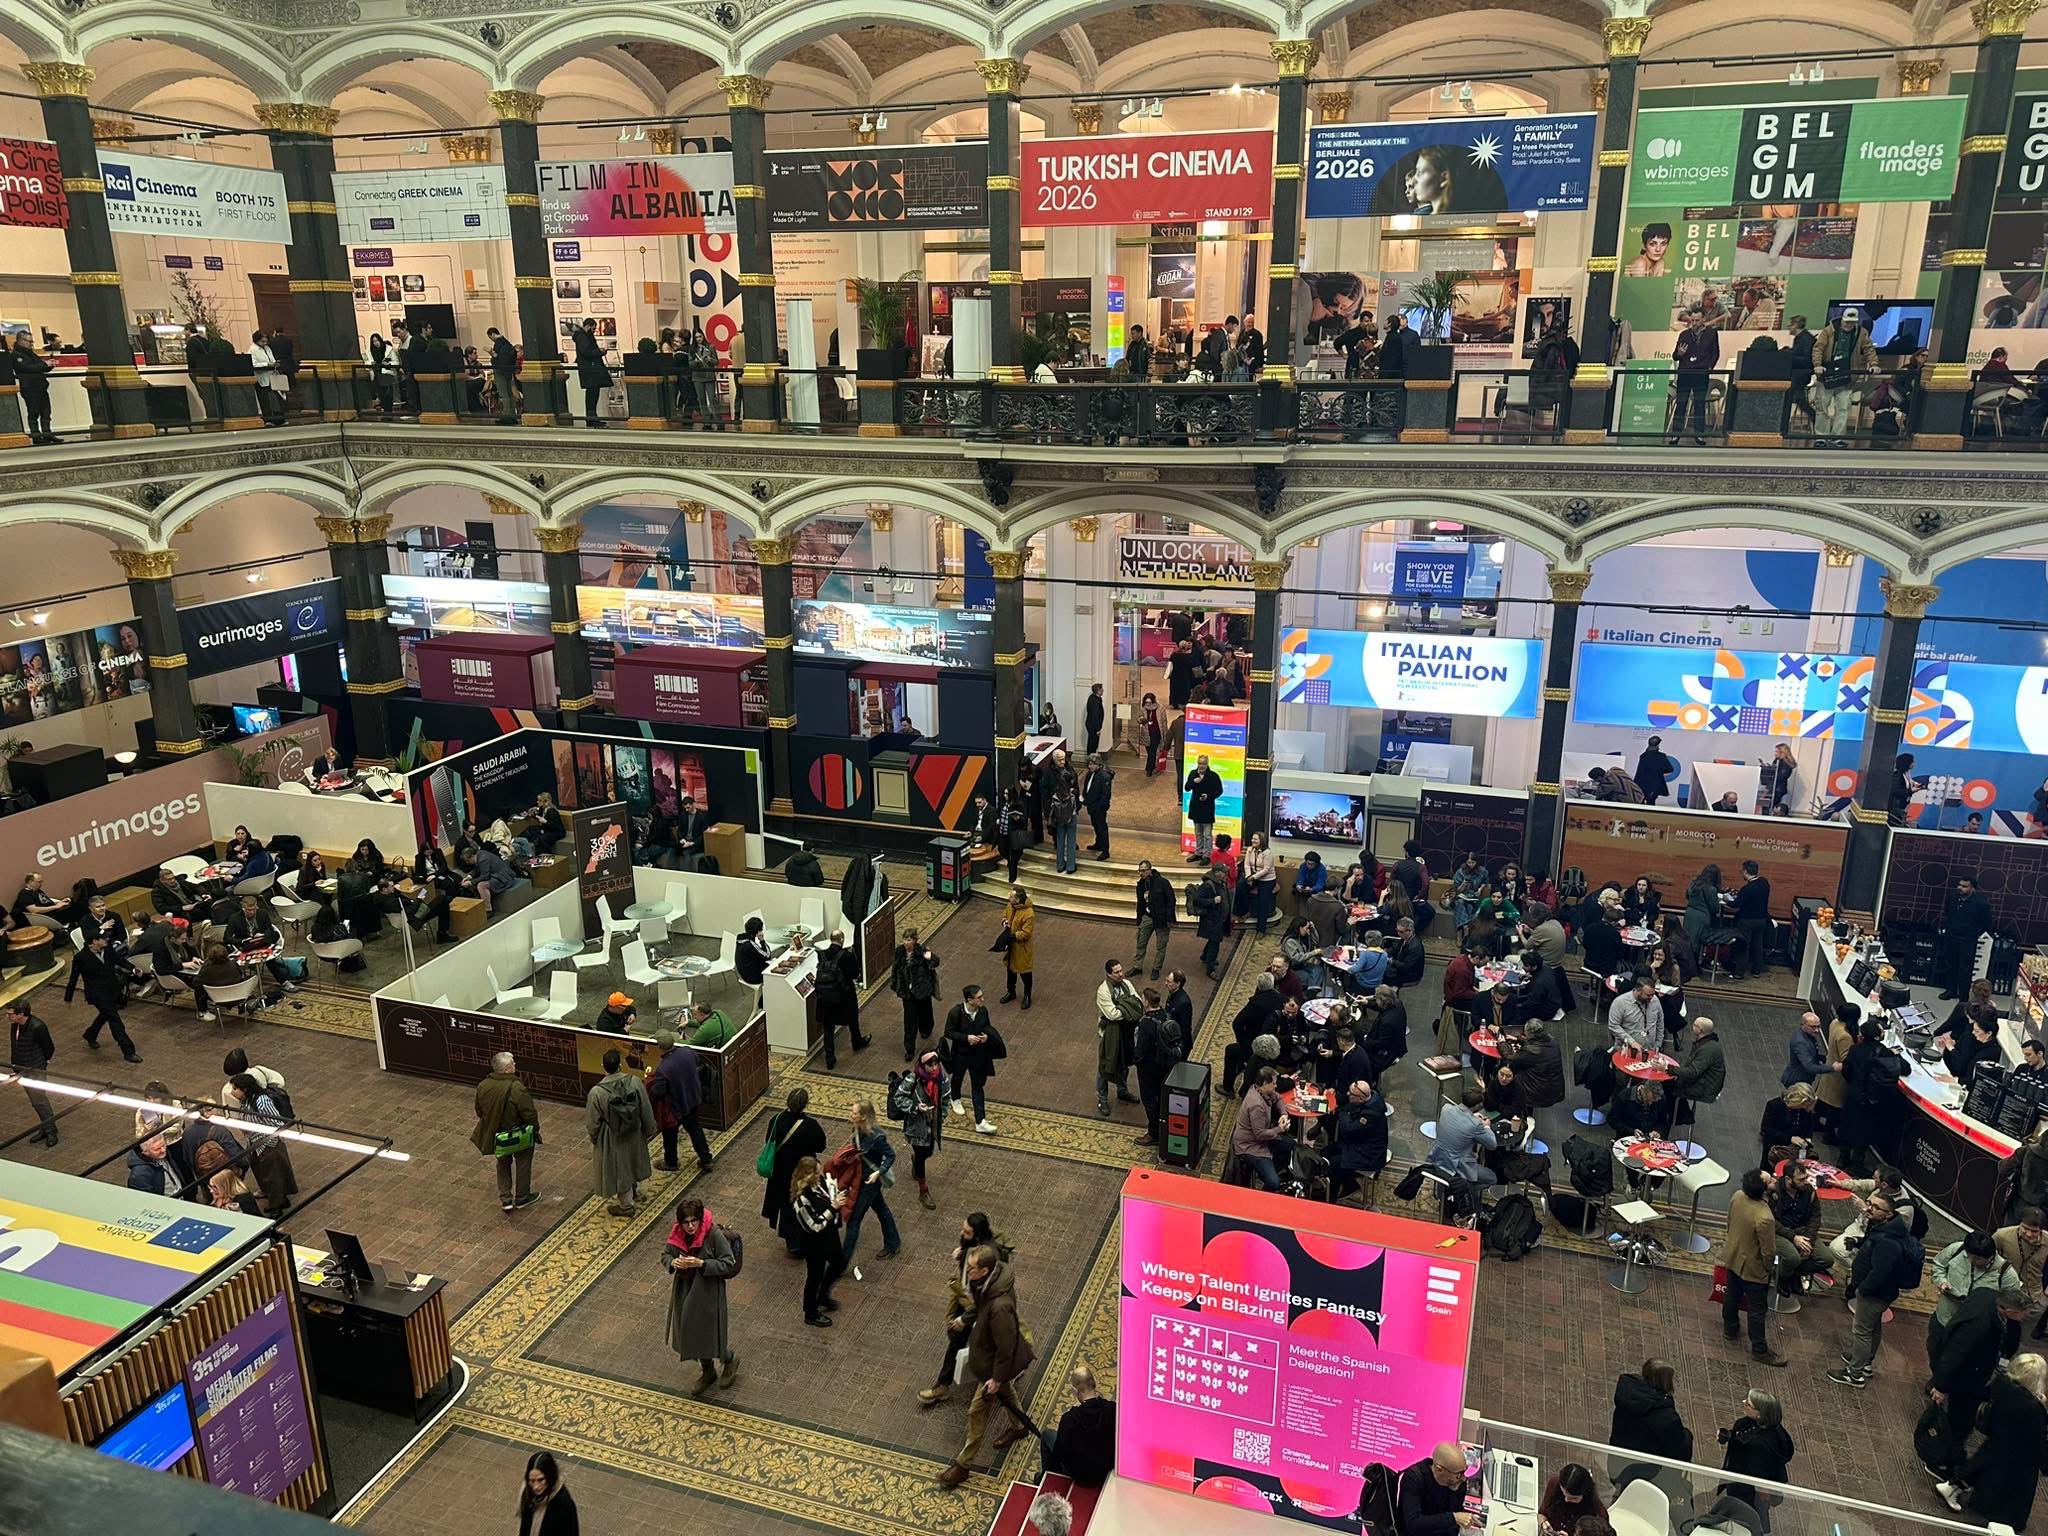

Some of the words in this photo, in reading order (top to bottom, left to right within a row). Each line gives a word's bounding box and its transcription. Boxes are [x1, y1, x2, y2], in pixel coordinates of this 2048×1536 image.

[1515, 124, 1553, 132] Generation
[1333, 139, 1381, 147] NETHERLANDS
[1514, 133, 1521, 142] A
[1524, 131, 1562, 141] FAMILY
[1316, 149, 1360, 158] BERLINALE
[1859, 140, 1944, 159] flanders
[1037, 153, 1138, 182] TURKISH
[1147, 148, 1253, 179] CINEMA
[1315, 158, 1374, 179] 2026
[1644, 164, 1729, 180] wbimages
[1880, 157, 1943, 176] image
[539, 164, 607, 192] FILM
[626, 161, 660, 188] IN
[105, 173, 131, 192] Rai
[136, 177, 198, 198] Cinema
[216, 191, 256, 206] BOOTH
[258, 196, 275, 207] 175
[355, 190, 396, 201] Connecting
[398, 189, 427, 199] GREEK
[429, 187, 463, 197] CINEMA
[1037, 185, 1097, 211] 2026
[6, 192, 68, 217] Polish
[107, 202, 201, 218] INTERNATIONAL
[541, 199, 559, 211] find
[561, 202, 571, 210] us
[610, 190, 735, 220] ALBANIA
[1205, 208, 1232, 217] STAND
[1233, 207, 1253, 216] #129
[109, 213, 203, 227] DISTRIBUTION
[218, 208, 243, 220] FIRST
[247, 210, 277, 222] FLOOR
[543, 214, 553, 222] at
[554, 212, 589, 223] Gropius
[544, 224, 564, 235] Park
[1123, 541, 1205, 561] UNLOCK
[1210, 543, 1255, 562] THE
[199, 619, 283, 648] eurimages
[1603, 629, 1654, 642] Italian
[1660, 632, 1722, 646] Cinema
[1382, 642, 1472, 661] ITALIAN
[1948, 653, 1977, 662] affair
[7, 667, 77, 693] LANGUAGE
[98, 652, 143, 671] CINEMA
[1398, 661, 1507, 682] PAVILION
[465, 685, 494, 693] Commission
[667, 701, 700, 710] Commission
[473, 758, 498, 775] SAUDI
[499, 746, 527, 765] ARABIA
[474, 774, 484, 783] THE
[484, 766, 504, 779] KINGDOM
[481, 774, 505, 788] CINEMATIC
[505, 763, 528, 777] TREASURES
[36, 791, 201, 867] eurimages
[1675, 829, 1716, 839] MOROCCO
[590, 834, 617, 849] 30%
[591, 843, 617, 856] CASH
[1777, 839, 1799, 847] Stories
[1781, 845, 1798, 853] Light
[140, 1208, 174, 1221] MEDIA
[97, 1224, 147, 1242] Creative
[117, 1217, 161, 1233] Europe
[1141, 1261, 1195, 1284] Where
[1199, 1273, 1250, 1296] Talent
[1254, 1285, 1313, 1308] Ignites
[1317, 1297, 1387, 1325] Fantasy
[1141, 1280, 1194, 1304] Keeps
[1196, 1294, 1217, 1308] on
[1221, 1297, 1285, 1325] Blazing
[1426, 1304, 1452, 1316] Spain
[222, 1343, 240, 1365] MEDIA
[254, 1344, 278, 1371] FILMS
[1289, 1344, 1319, 1359] Meet
[1321, 1348, 1339, 1363] the
[1342, 1355, 1391, 1374] Spanish
[1289, 1357, 1355, 1380] Delegation!
[205, 1370, 232, 1398] MEDIA
[1282, 1447, 1311, 1460] Cinema
[1259, 1490, 1283, 1503] ICEX
